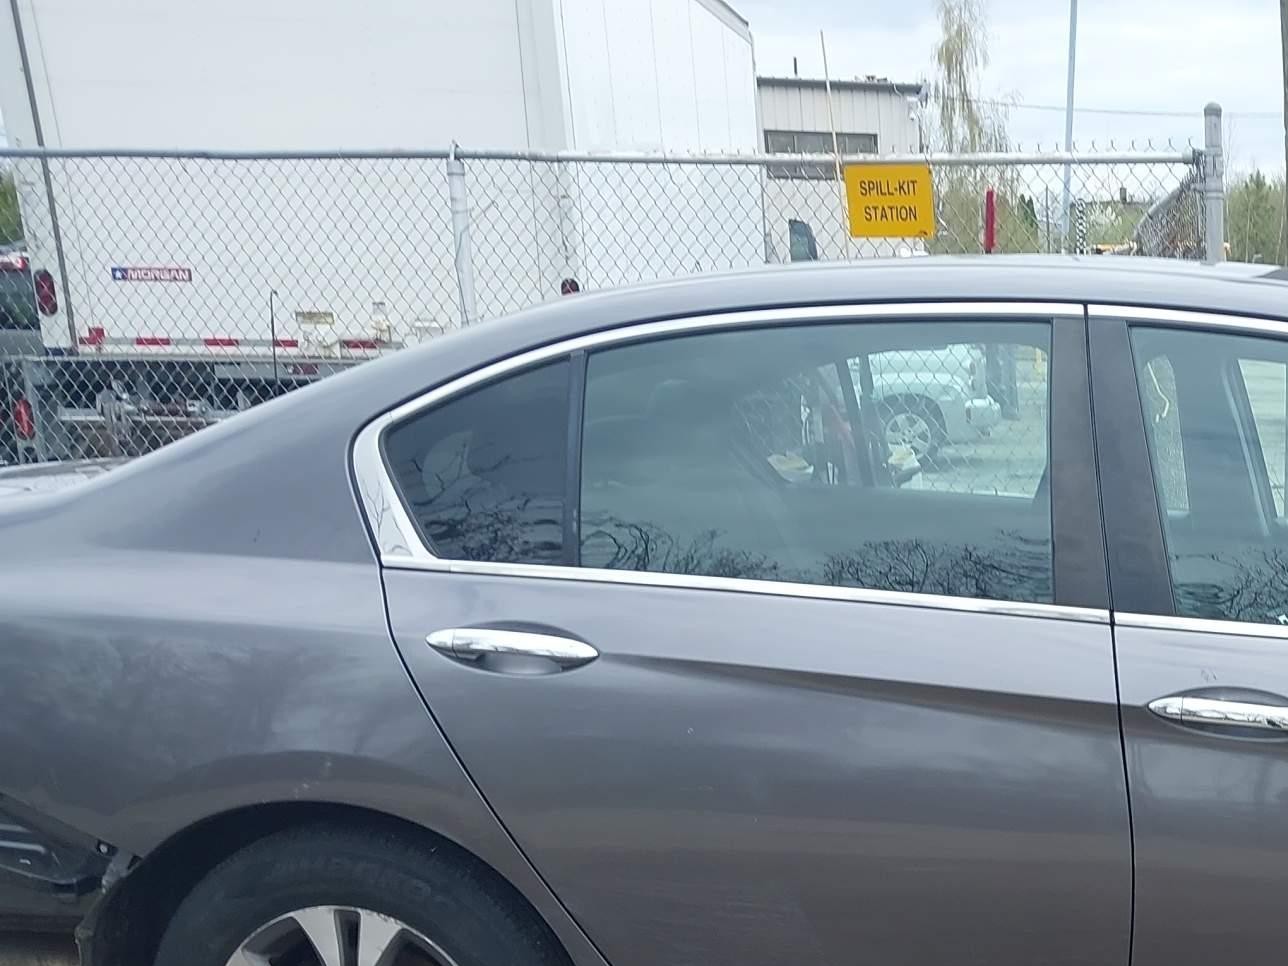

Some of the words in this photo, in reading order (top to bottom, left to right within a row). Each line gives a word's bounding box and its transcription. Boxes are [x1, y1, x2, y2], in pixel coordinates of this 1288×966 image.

[859, 179, 917, 197] SPILL-KIT
[864, 204, 918, 222] STATION
[127, 268, 190, 281] MORGAN
